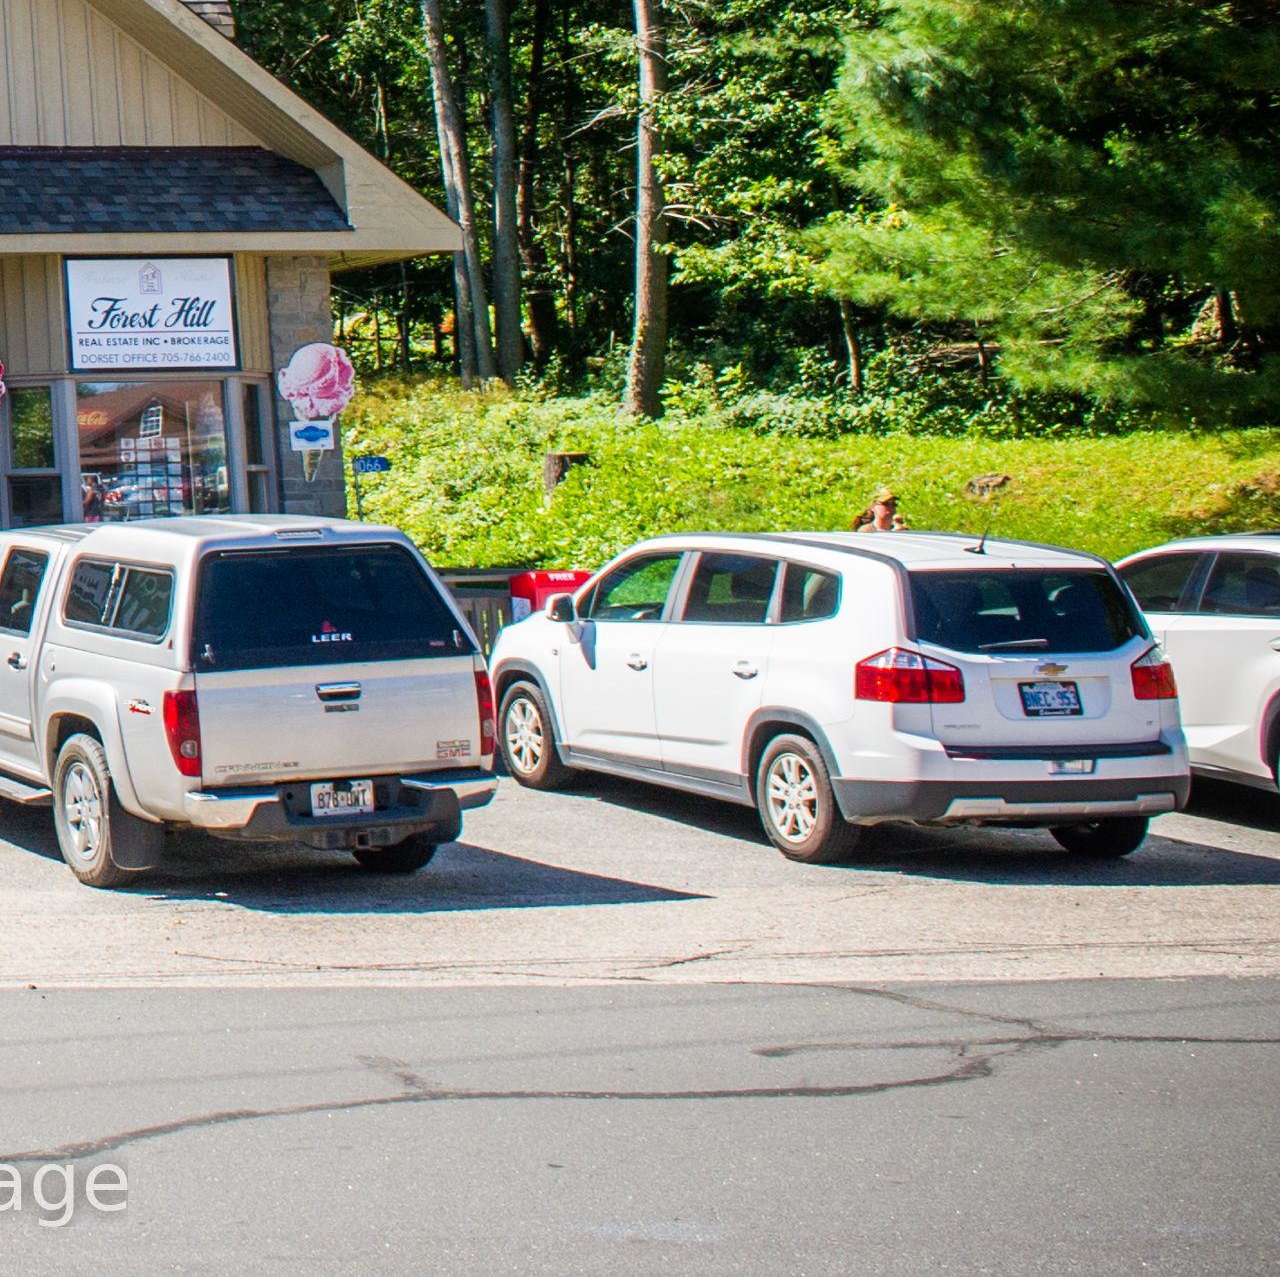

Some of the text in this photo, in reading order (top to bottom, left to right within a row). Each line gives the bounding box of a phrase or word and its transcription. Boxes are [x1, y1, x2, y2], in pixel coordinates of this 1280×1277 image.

[88, 296, 216, 330] Forest Hill
[78, 336, 229, 347] REAL ESTATE INC BROKERAGE
[81, 352, 230, 363] DORSET OFFICE 705-766-2400
[312, 633, 352, 643] LEER
